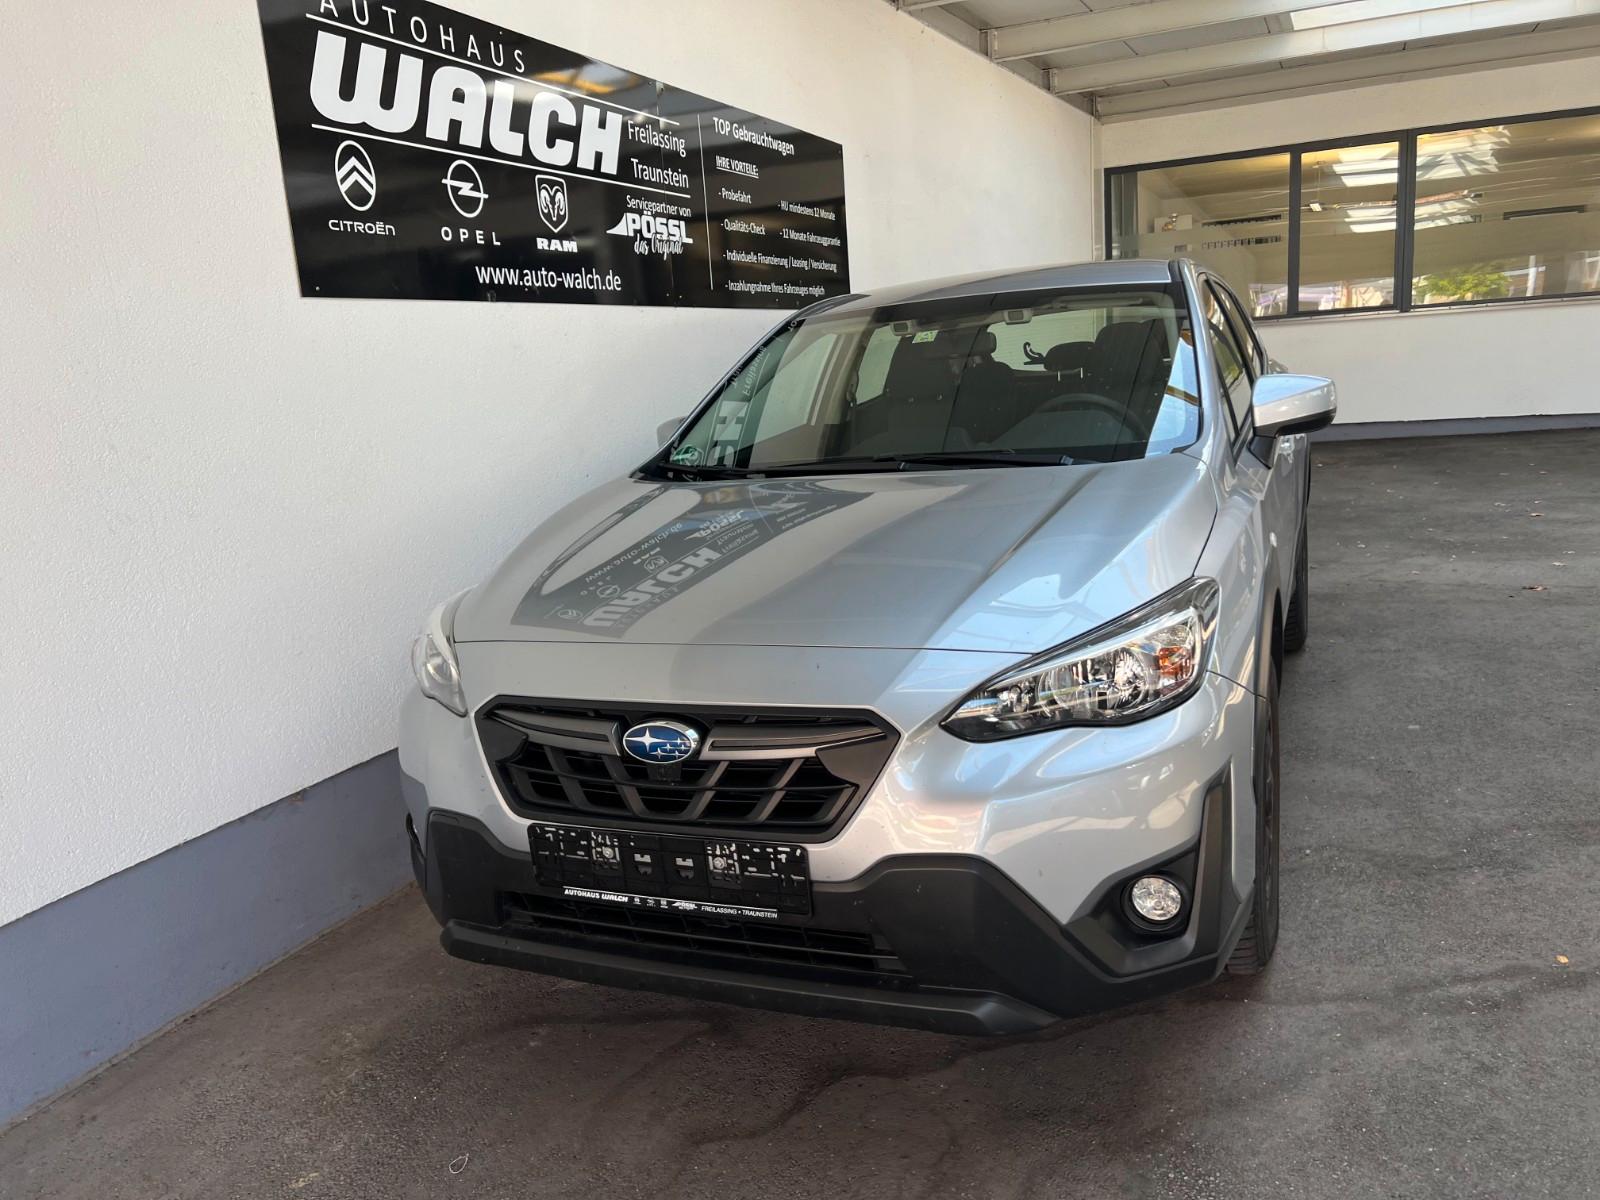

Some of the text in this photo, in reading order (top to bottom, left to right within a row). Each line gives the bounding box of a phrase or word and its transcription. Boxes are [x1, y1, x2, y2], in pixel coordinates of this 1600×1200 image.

[310, 30, 623, 175] WALCH
[628, 120, 687, 158] Freilassing
[713, 116, 795, 157] TOP Gebrauchtwagen
[631, 158, 689, 189] Traunstein
[716, 155, 759, 176] IHRE VORTEILE:
[626, 194, 692, 217] Servicepartner von
[722, 187, 752, 204] Probefahrt
[328, 219, 396, 237] CITROËN
[441, 226, 501, 246] OPEL
[626, 210, 693, 244] PÖSSL
[724, 218, 766, 235] Qualitäts-Check
[536, 237, 578, 253] RAM
[634, 233, 650, 256] das
[726, 250, 757, 264] Individuelle
[475, 266, 622, 291] www.auto-walch.de
[564, 889, 629, 903] AUTOHAUS WALCH
[702, 906, 778, 919] FREILASSING TRAUNSTEIN
